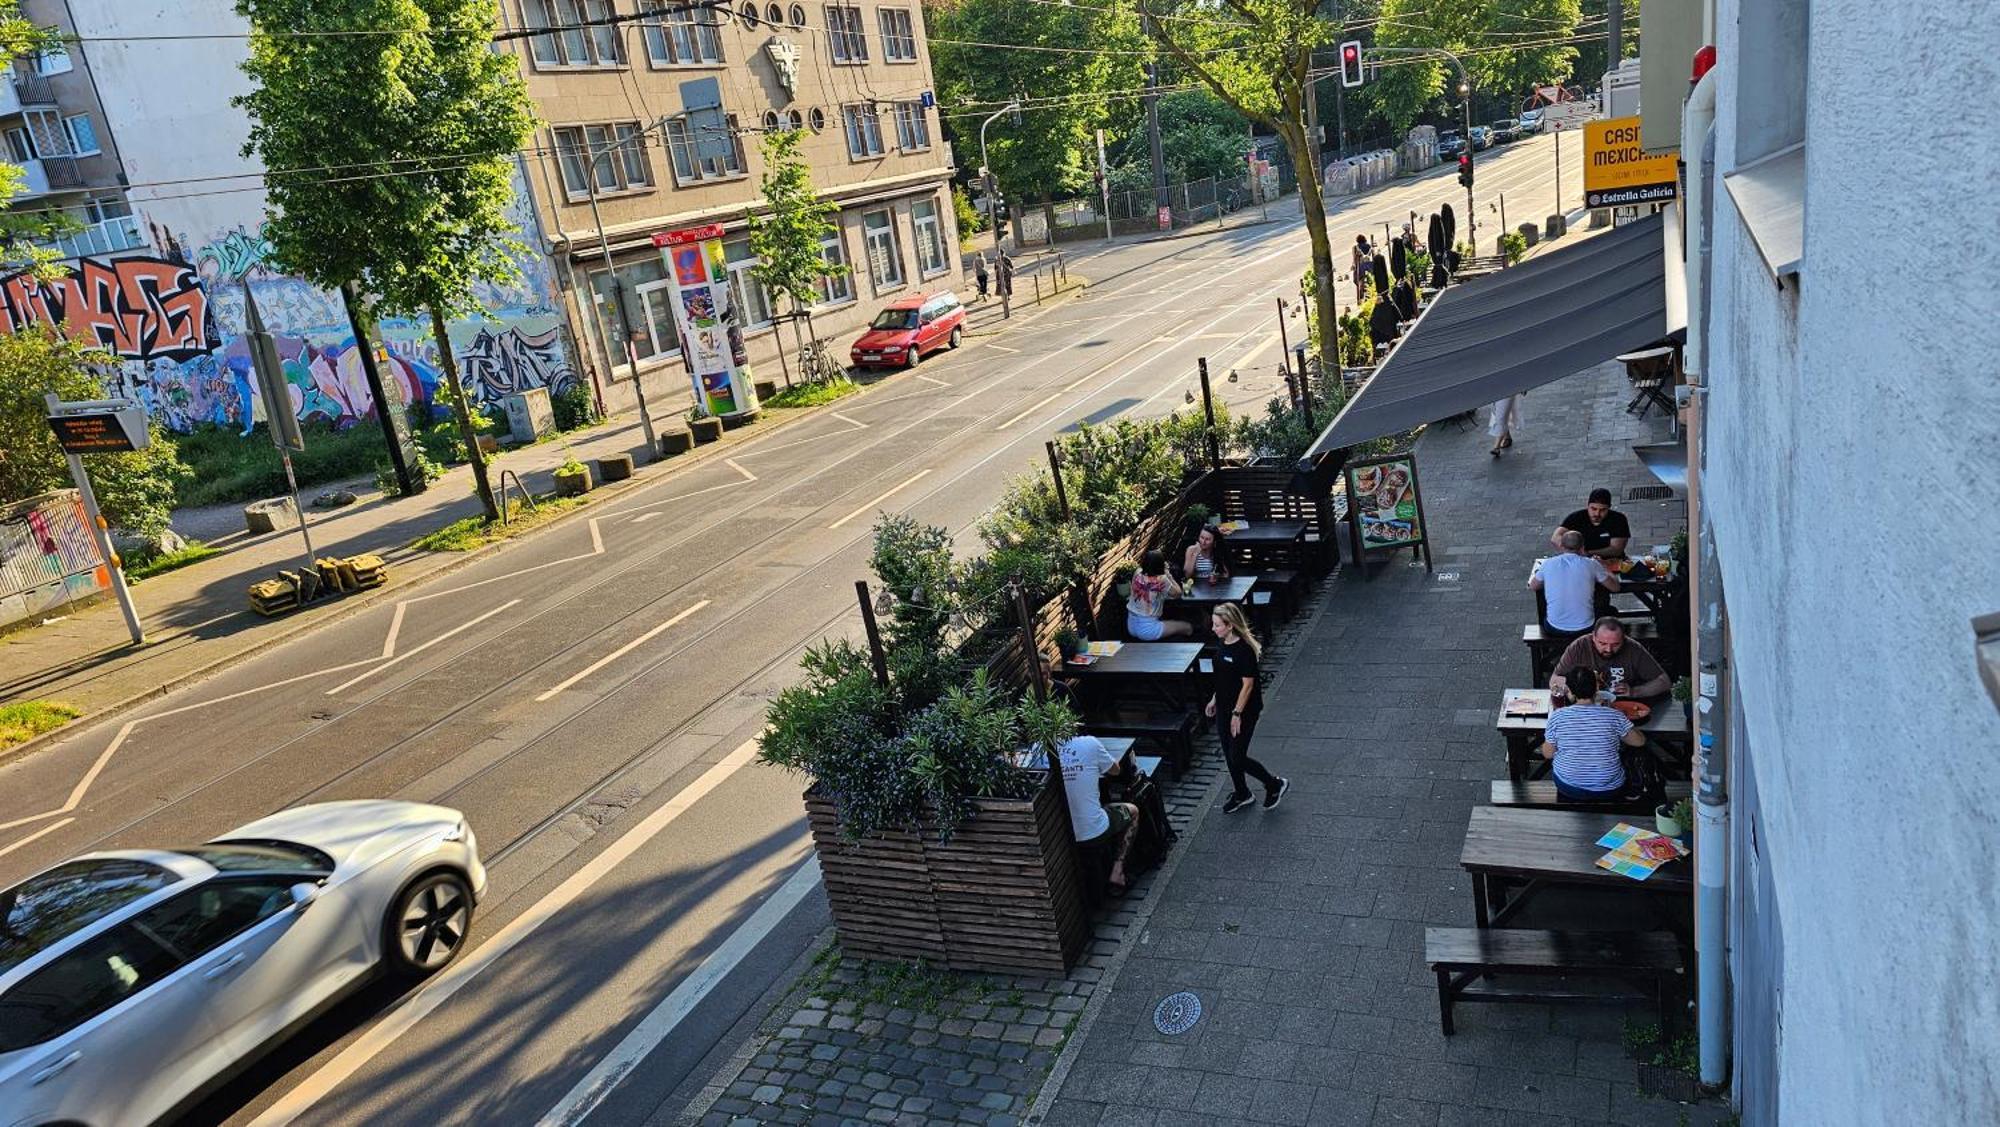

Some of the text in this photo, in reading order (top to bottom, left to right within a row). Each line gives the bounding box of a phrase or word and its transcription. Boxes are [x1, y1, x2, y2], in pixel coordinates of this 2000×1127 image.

[1604, 125, 1641, 145] CASI
[1601, 186, 1674, 204] Estrella Galicia
